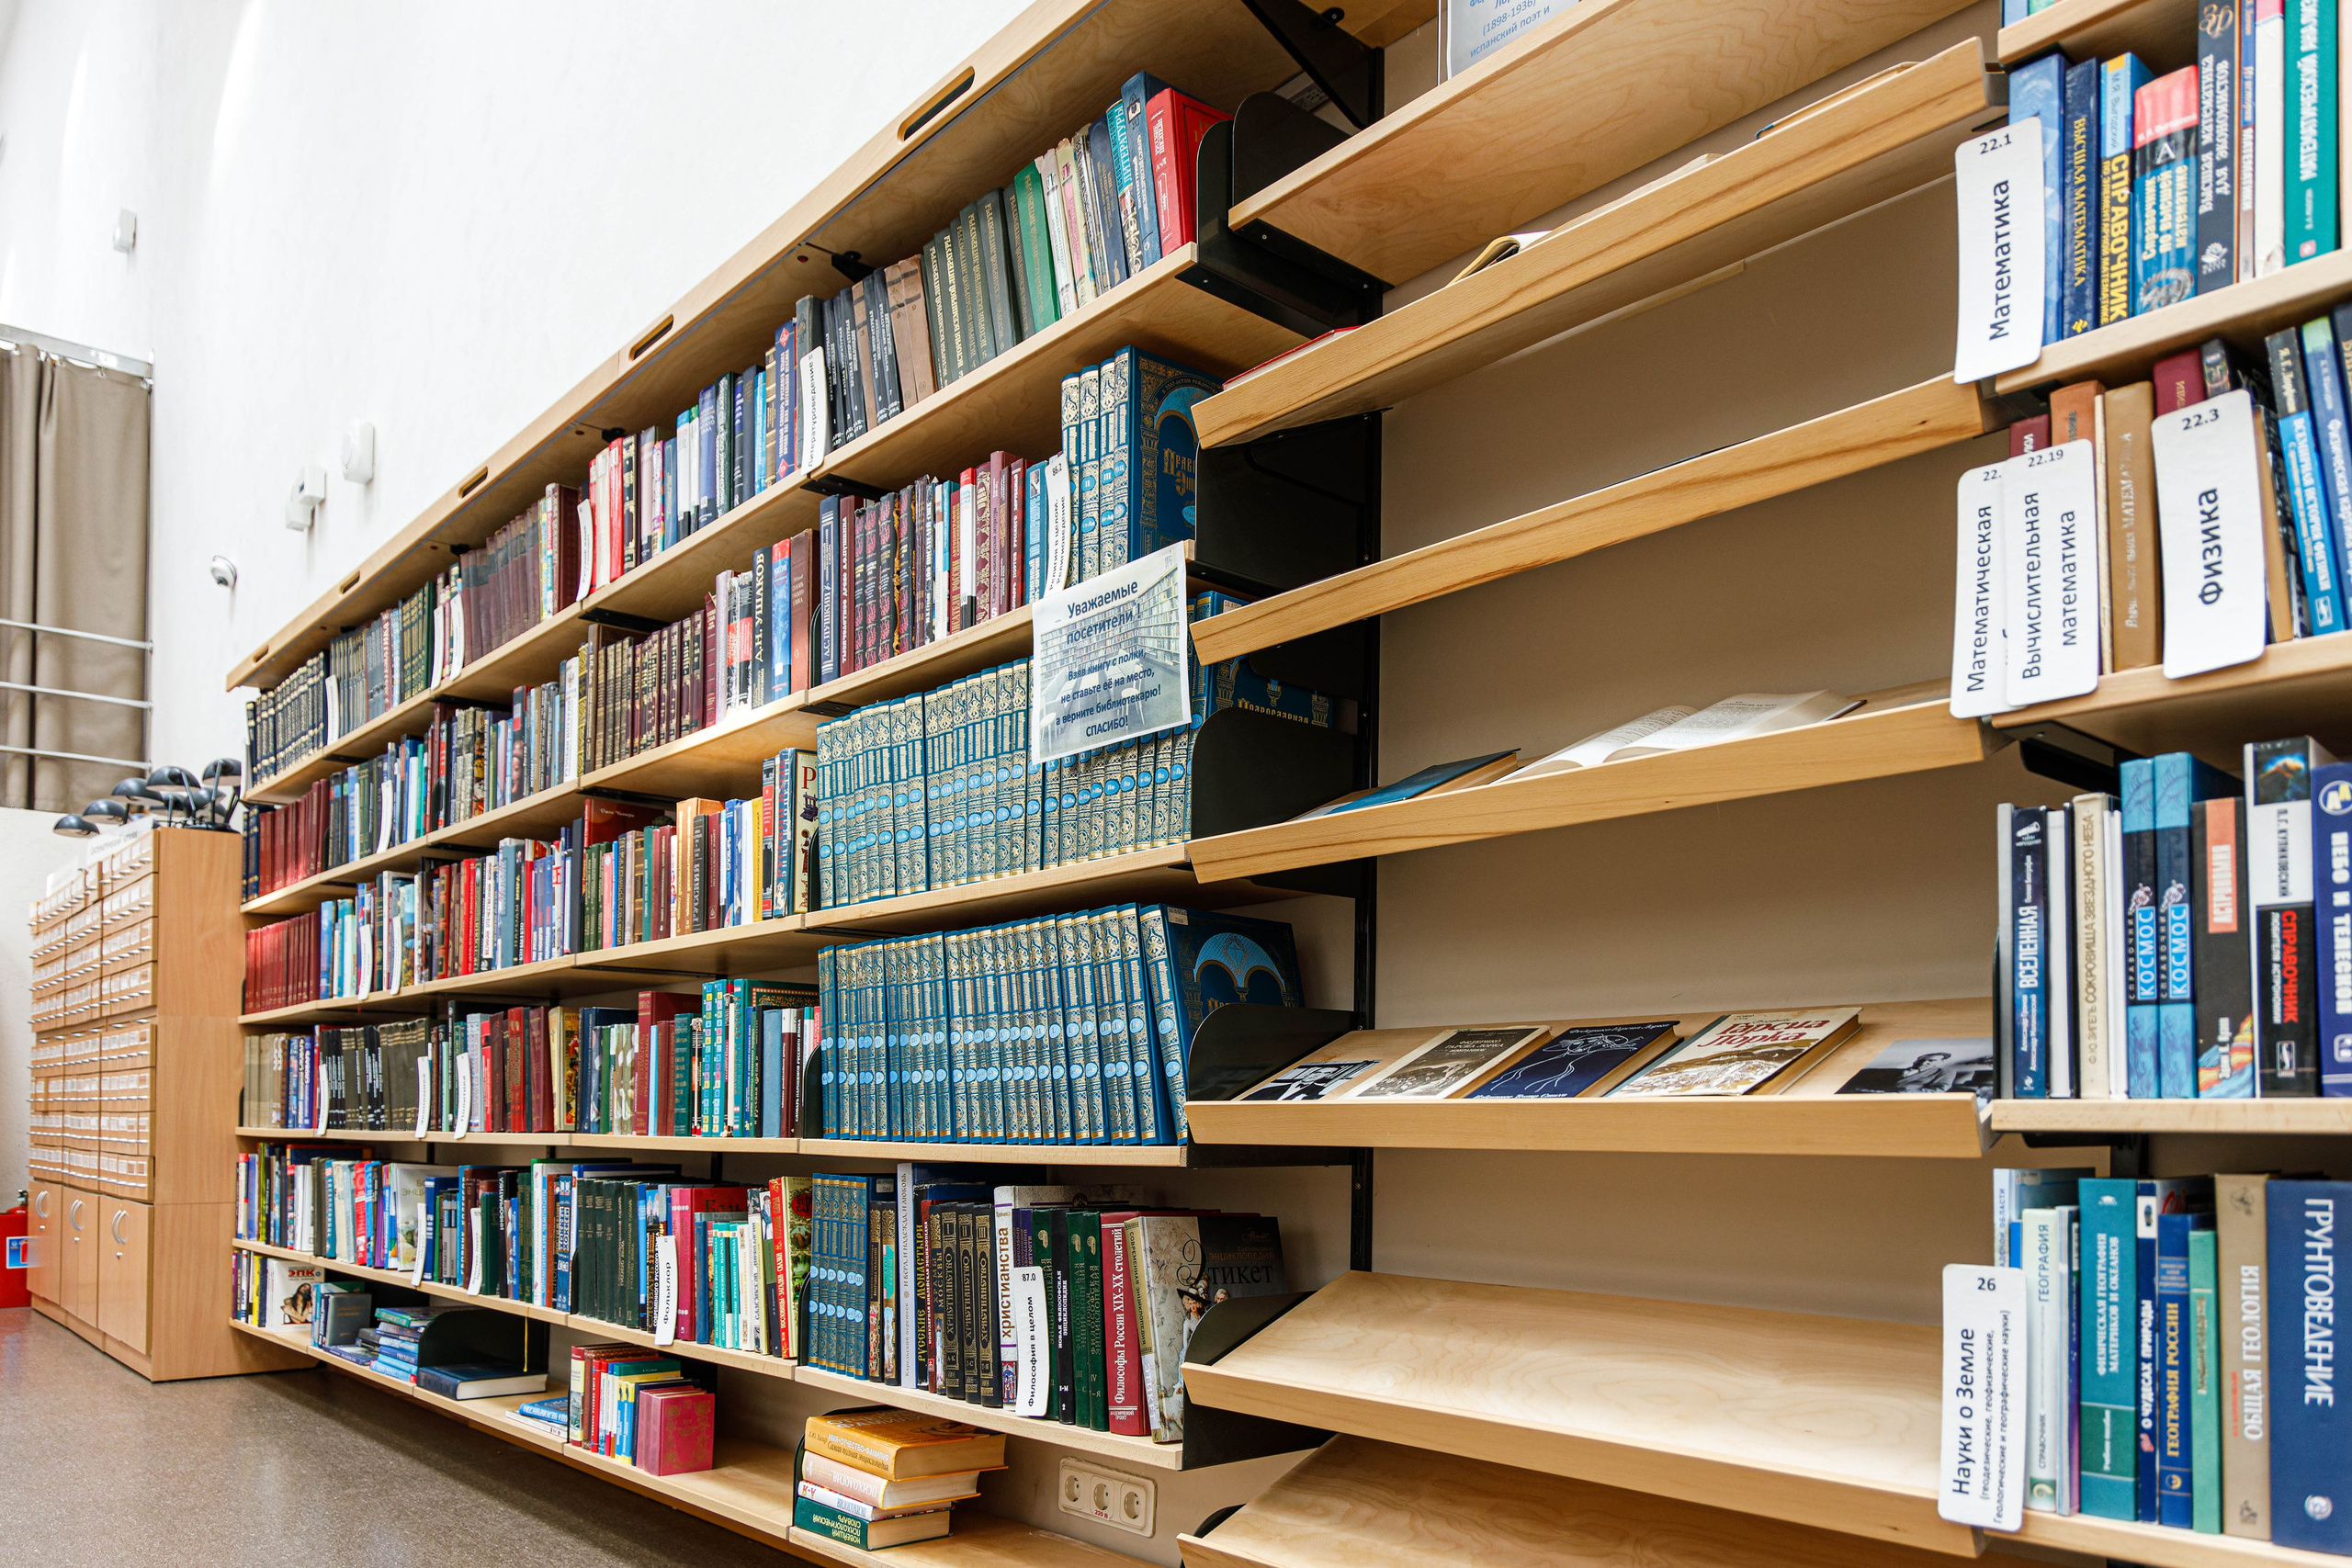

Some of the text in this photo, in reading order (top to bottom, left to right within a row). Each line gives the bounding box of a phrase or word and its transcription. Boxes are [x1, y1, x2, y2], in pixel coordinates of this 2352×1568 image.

[1470, 6, 1550, 58] испанский поэт и
[1114, 104, 1134, 185] ЛИТЕРАТУРЫ
[1979, 133, 2012, 155] 22.1
[2073, 117, 2089, 288] ВЫСШАЯ МАТЕМАТИКА
[2109, 152, 2131, 322] СПРАВОЧНИК
[2142, 175, 2159, 261] Справочник
[2175, 164, 2188, 249] математике
[1989, 179, 2010, 342] Математика
[2100, 256, 2110, 325] МАТЕМАТИКЕ
[2182, 408, 2221, 433] 22.3
[2027, 448, 2064, 468] 22.19
[1049, 548, 1059, 591] Религия
[1057, 495, 1067, 584] Религиоведение
[2198, 487, 2223, 606] Физика
[754, 552, 765, 626] УШАКОВ
[1067, 580, 1139, 620] Уважаемые
[1966, 504, 1993, 693] Математическая
[2021, 491, 2041, 680] Вычислительная
[2061, 510, 2078, 647] математика
[822, 591, 831, 639] ПУШКИН
[1066, 610, 1134, 646] посетители
[1060, 668, 1155, 705] не ставьте её на место,
[1068, 666, 1087, 682] Взяв
[1087, 660, 1111, 678] книгу
[1118, 648, 1148, 666] полки,
[1056, 684, 1162, 727] а верните библиотекарю!
[1085, 714, 1129, 738] СПАСИБО!
[2330, 830, 2350, 885] НЕБО
[2082, 813, 2098, 1004] СОКРОВИЩА ЗВЕЗДНОГО НЕБА
[2018, 905, 2039, 989] ВСЕЛЕННАЯ
[2137, 911, 2155, 997] КОСМОС
[2170, 908, 2188, 996] КОСМОС
[2280, 908, 2300, 1023] СПРАВОЧНИК
[2334, 913, 2352, 1015] ТЕЛЕСКОП
[1696, 1031, 1808, 1049] Лорка
[1716, 1020, 1831, 1037] Гарсиа
[998, 1226, 1012, 1339] христианства
[1022, 1272, 1036, 1282] 87.0
[1110, 1227, 1123, 1271] столетий
[1977, 1277, 1996, 1292] 26
[2038, 1224, 2050, 1302] ГЕОГРАФИЯ
[2109, 1235, 2120, 1292] ОКЕАНОВ
[662, 1261, 672, 1325] Фольклор
[915, 1224, 927, 1362] РУССКИЕ МОНАСТЫРИ
[944, 1252, 955, 1334] ХРИСТИАНСТВО
[962, 1255, 972, 1338] ХРИСТИАНСТВО
[978, 1257, 989, 1342] ХРИСТИАНСТВО
[1026, 1295, 1035, 1333] целом
[1129, 1231, 1147, 1345] СОВРЕМЕННАЯ ЭНЦИКЛОПЕДИЯ
[2096, 1233, 2108, 1376] ФИЗИЧЕСКАЯ ГЕОГРАФИЯ
[2303, 1198, 2335, 1408] ГРУНТОВЕДЕНИЕ
[1114, 1313, 1125, 1348] России
[2000, 1309, 2013, 1346] науки)
[2109, 1304, 2120, 1372] МАТЕРИКОВ
[2165, 1302, 2179, 1367] РОССИИ
[2240, 1264, 2266, 1441] ОБЩАЯ ГЕОЛОГИЯ
[1027, 1343, 1038, 1407] Философия
[1113, 1349, 1127, 1404] Философы
[1999, 1348, 2012, 1434] географические
[2140, 1299, 2154, 1428] О ЧУДЕСАХ ПРИРОДЫ
[1951, 1327, 1975, 1496] Науки о Земле
[1979, 1329, 1996, 1500] (геодезические, геофизические,
[2039, 1413, 2048, 1470] СПРАВОЧНИК
[2165, 1370, 2180, 1457] ГЕОГРАФИЯ
[831, 1470, 877, 1498] ПСИХОЛОГИЯ
[1094, 1508, 1104, 1517] 220
[1993, 1445, 2008, 1524] Геологические
[812, 1513, 862, 1538] ПСИХОЛОГИЧЕСКИЙ
[831, 1528, 862, 1544] НОВЕЙШИЙ
[837, 1514, 862, 1529] СЛОВАРЬ
